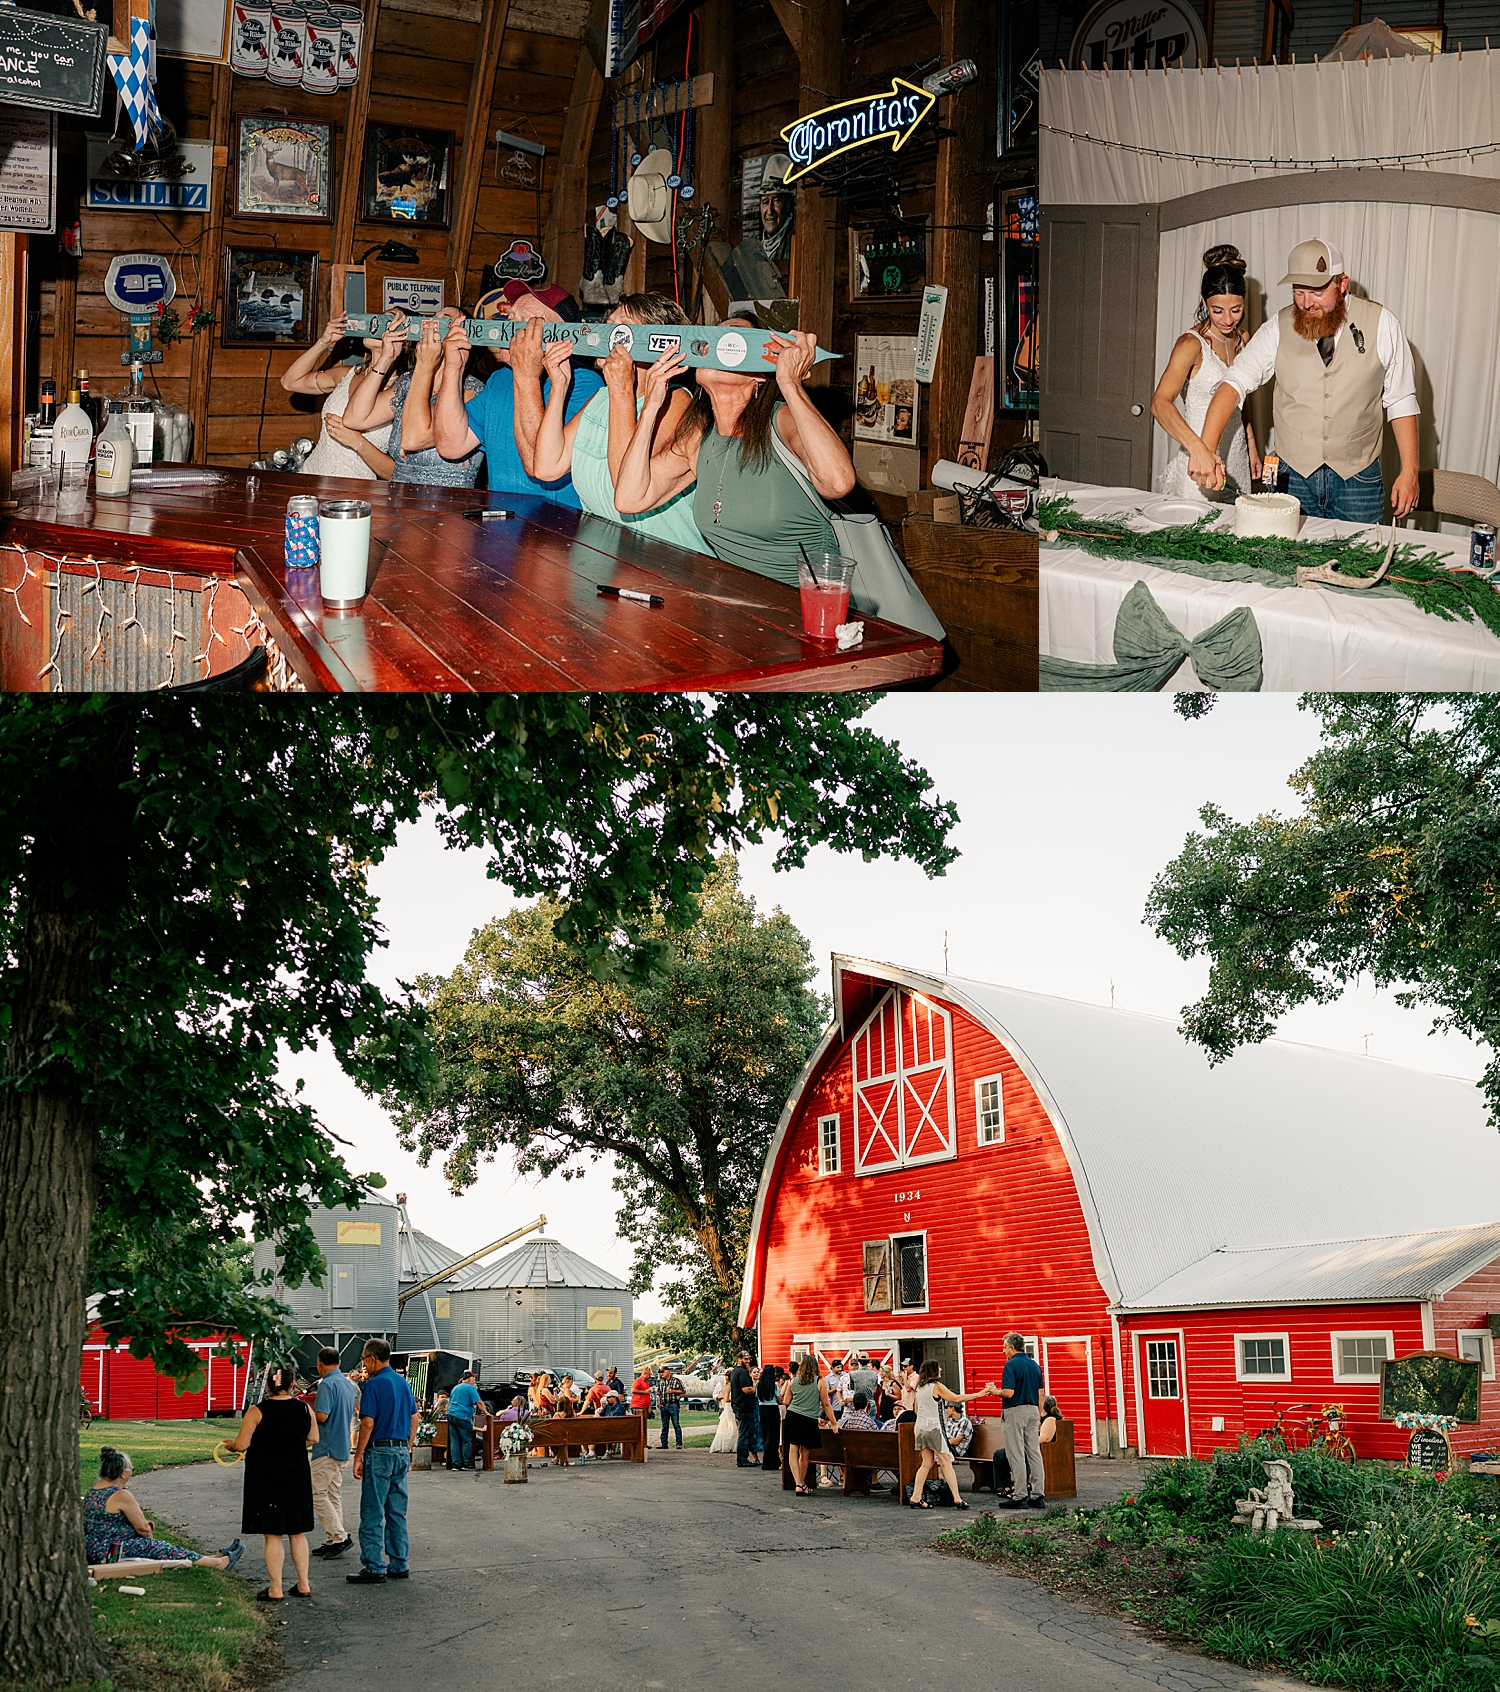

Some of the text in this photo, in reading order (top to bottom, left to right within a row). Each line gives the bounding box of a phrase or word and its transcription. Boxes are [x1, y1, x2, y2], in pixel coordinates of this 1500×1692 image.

[245, 22, 260, 31] Pabst
[1105, 7, 1168, 49] Miller
[250, 30, 266, 38] Ribbon
[281, 31, 296, 40] Pabst
[285, 40, 301, 48] Ribbon
[315, 41, 330, 49] Pabst
[31, 51, 49, 64] you
[54, 54, 74, 64] can
[320, 49, 336, 57] Ribbon
[93, 181, 204, 206] SCHLITZ
[864, 241, 919, 259] BEER
[117, 255, 161, 265] SCHLITZ
[388, 282, 441, 294] PUBLIC TELEPHONE
[651, 337, 678, 349] YETI
[894, 1190, 921, 1203] 1934
[1413, 1433, 1444, 1444] Timeline
